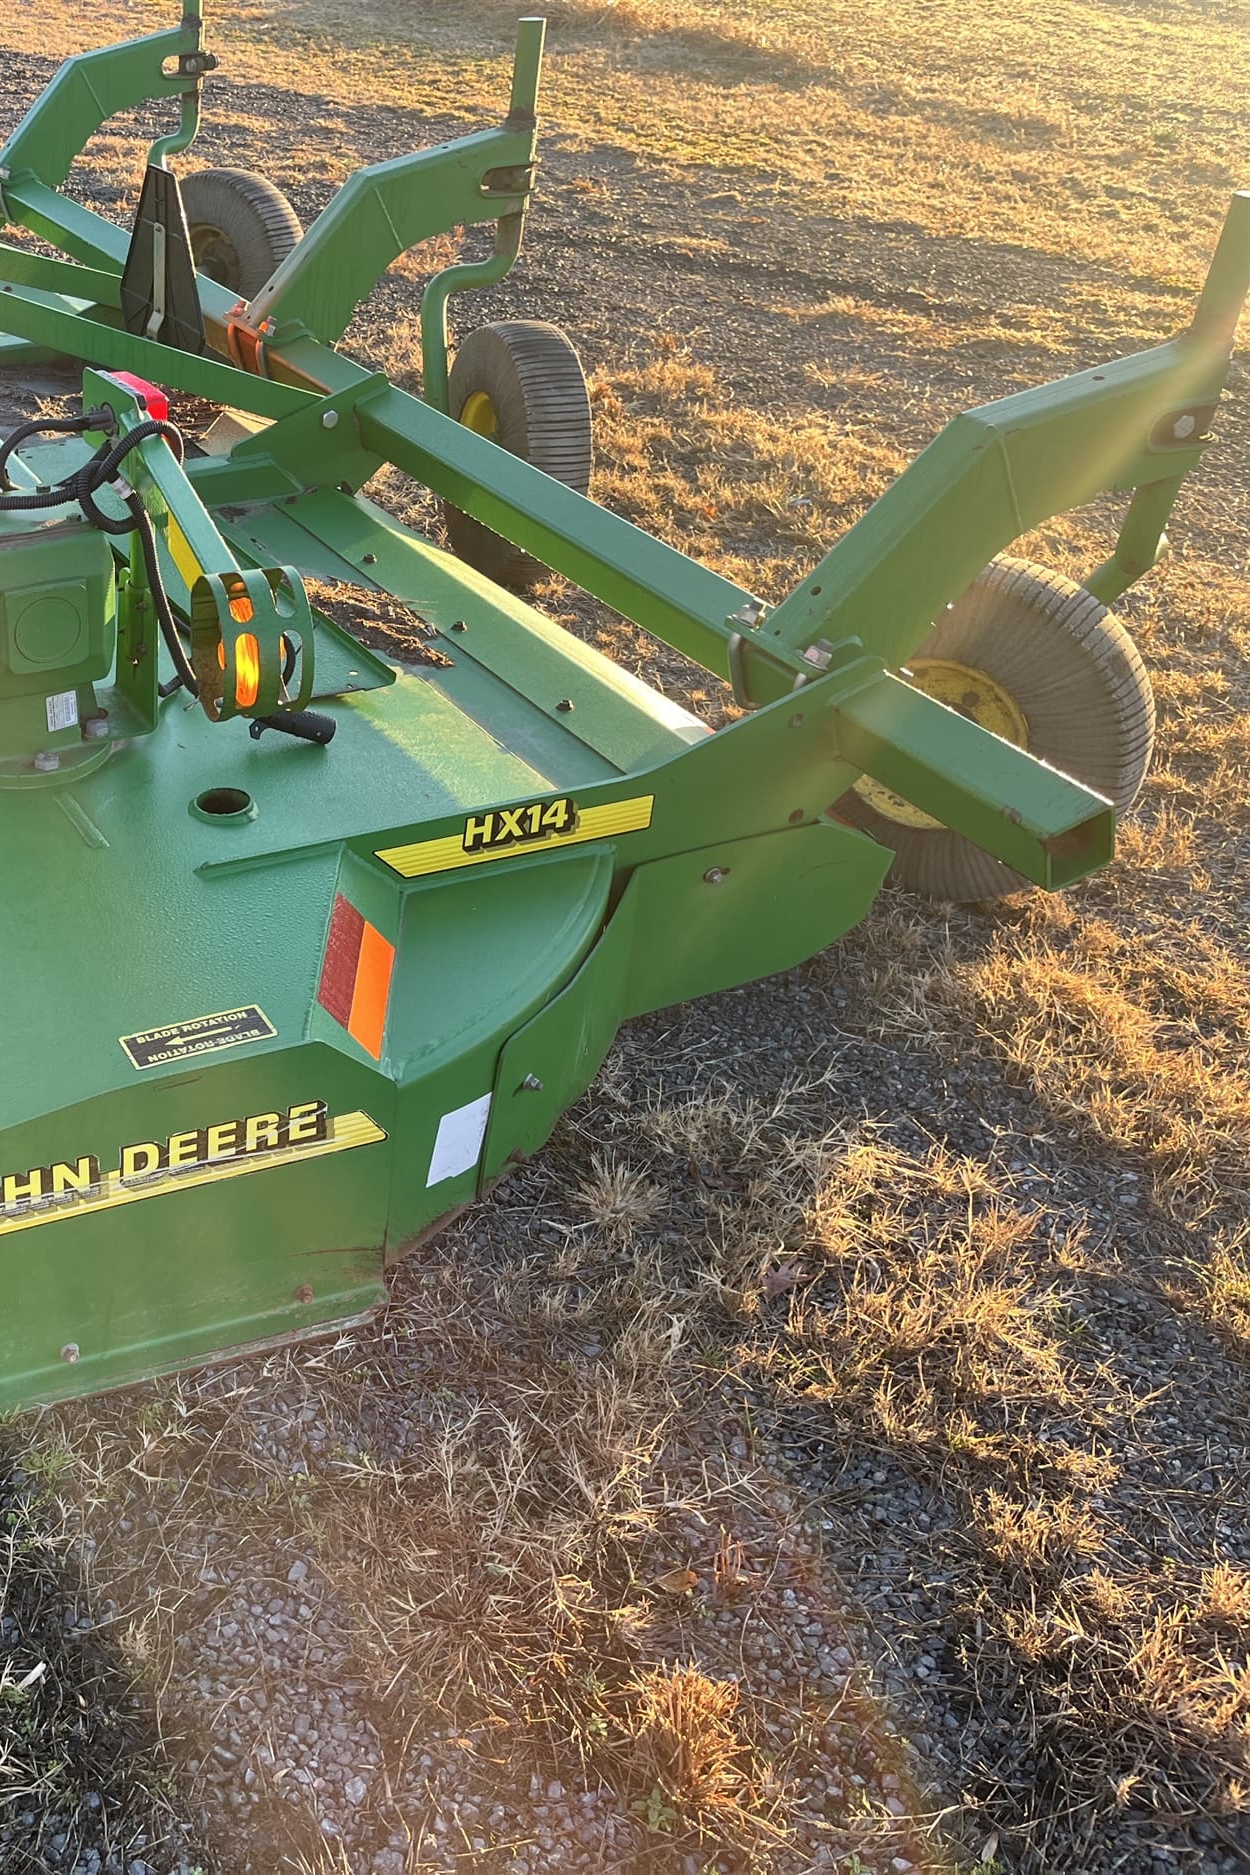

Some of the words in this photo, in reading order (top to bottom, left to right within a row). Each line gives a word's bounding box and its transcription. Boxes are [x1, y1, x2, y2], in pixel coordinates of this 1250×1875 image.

[462, 798, 575, 851] HX14
[136, 1025, 181, 1045] BLADE
[182, 1011, 248, 1033] ROTATION
[148, 1039, 217, 1063] ROTATION
[119, 1100, 328, 1188] DEERE
